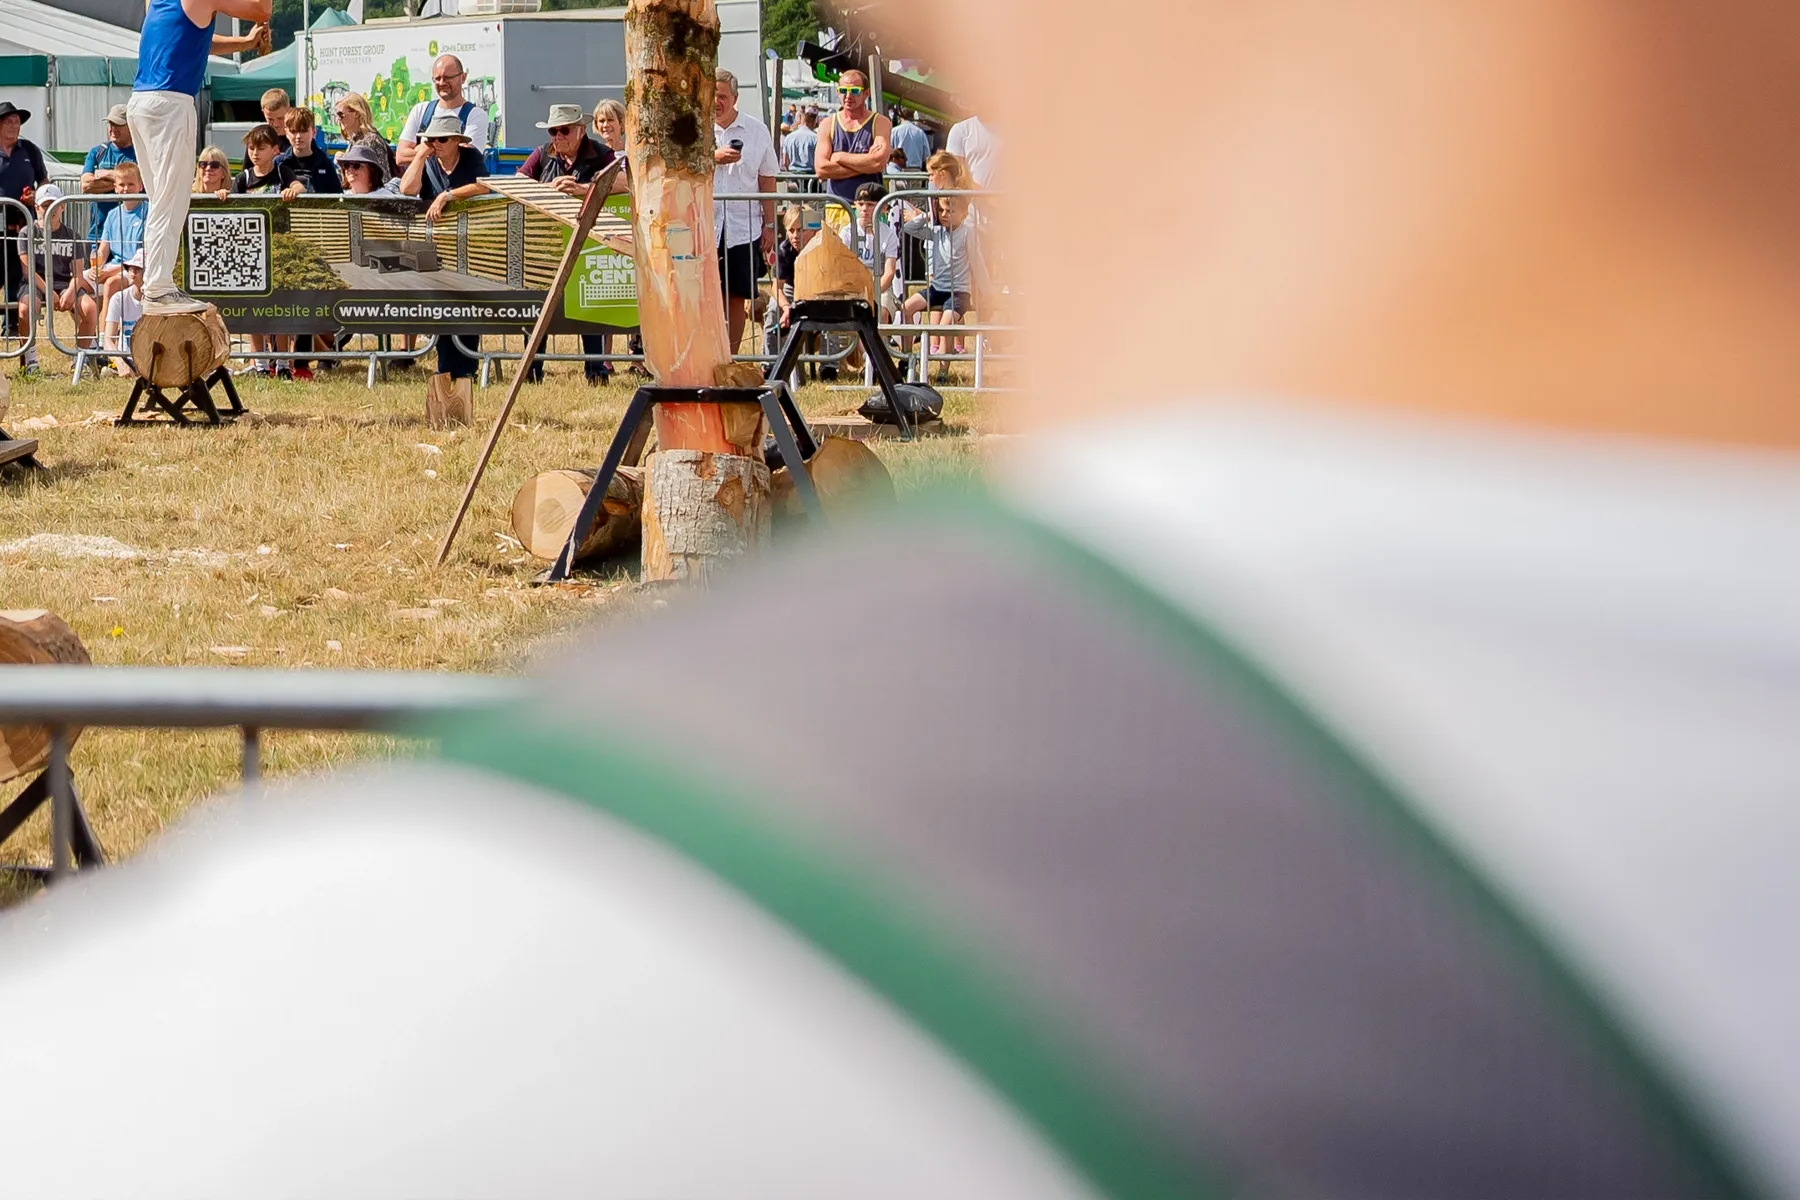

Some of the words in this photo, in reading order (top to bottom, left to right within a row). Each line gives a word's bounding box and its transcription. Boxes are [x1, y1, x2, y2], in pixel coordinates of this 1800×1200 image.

[320, 47, 338, 58] HUNT
[339, 46, 362, 56] FOREST
[363, 44, 385, 55] GROUP
[440, 44, 457, 53] JOHN
[457, 43, 476, 52] DEERE
[585, 255, 634, 269] FENC
[589, 270, 636, 284] CENT
[218, 307, 247, 317] our
[252, 304, 310, 317] website
[315, 305, 329, 317] at
[339, 304, 540, 319] www.fencingcentre.co.uk
